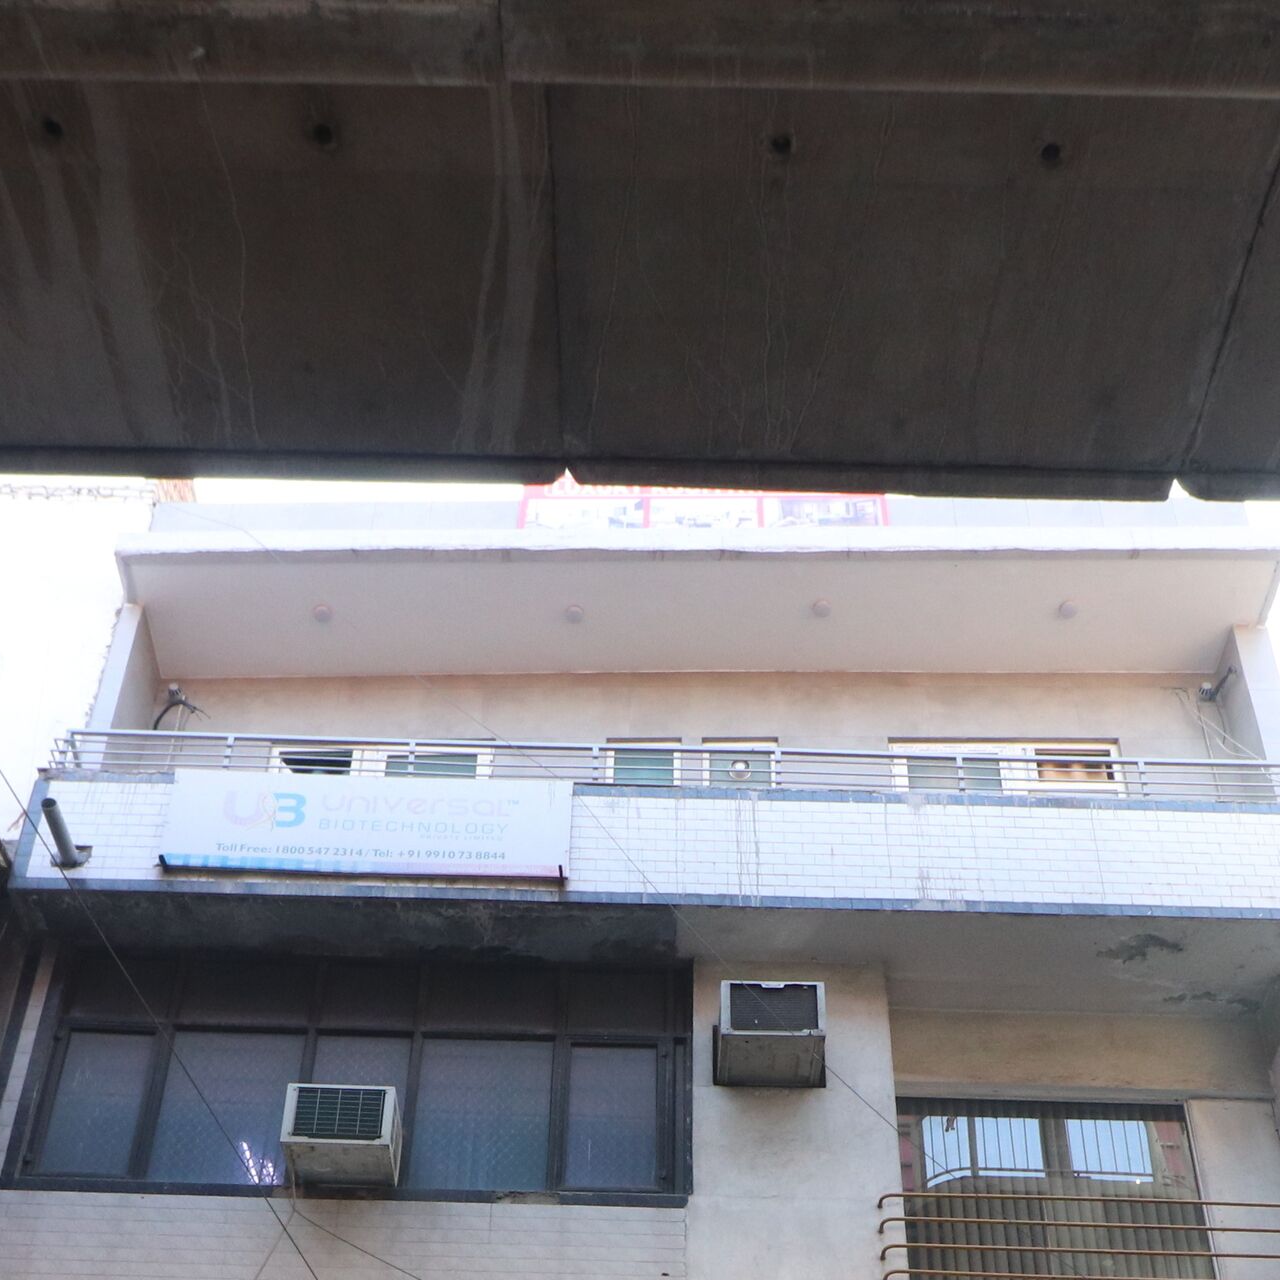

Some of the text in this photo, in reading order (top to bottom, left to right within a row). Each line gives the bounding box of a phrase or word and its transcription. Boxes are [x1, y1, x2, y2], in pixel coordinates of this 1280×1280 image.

[318, 818, 509, 836] BIOTECHNOLOGY
[215, 842, 238, 853] Toll
[239, 843, 273, 855] Free:
[275, 845, 304, 855] 1800
[306, 846, 331, 856] 547
[333, 847, 363, 857] 2314
[372, 848, 394, 859] Tel:
